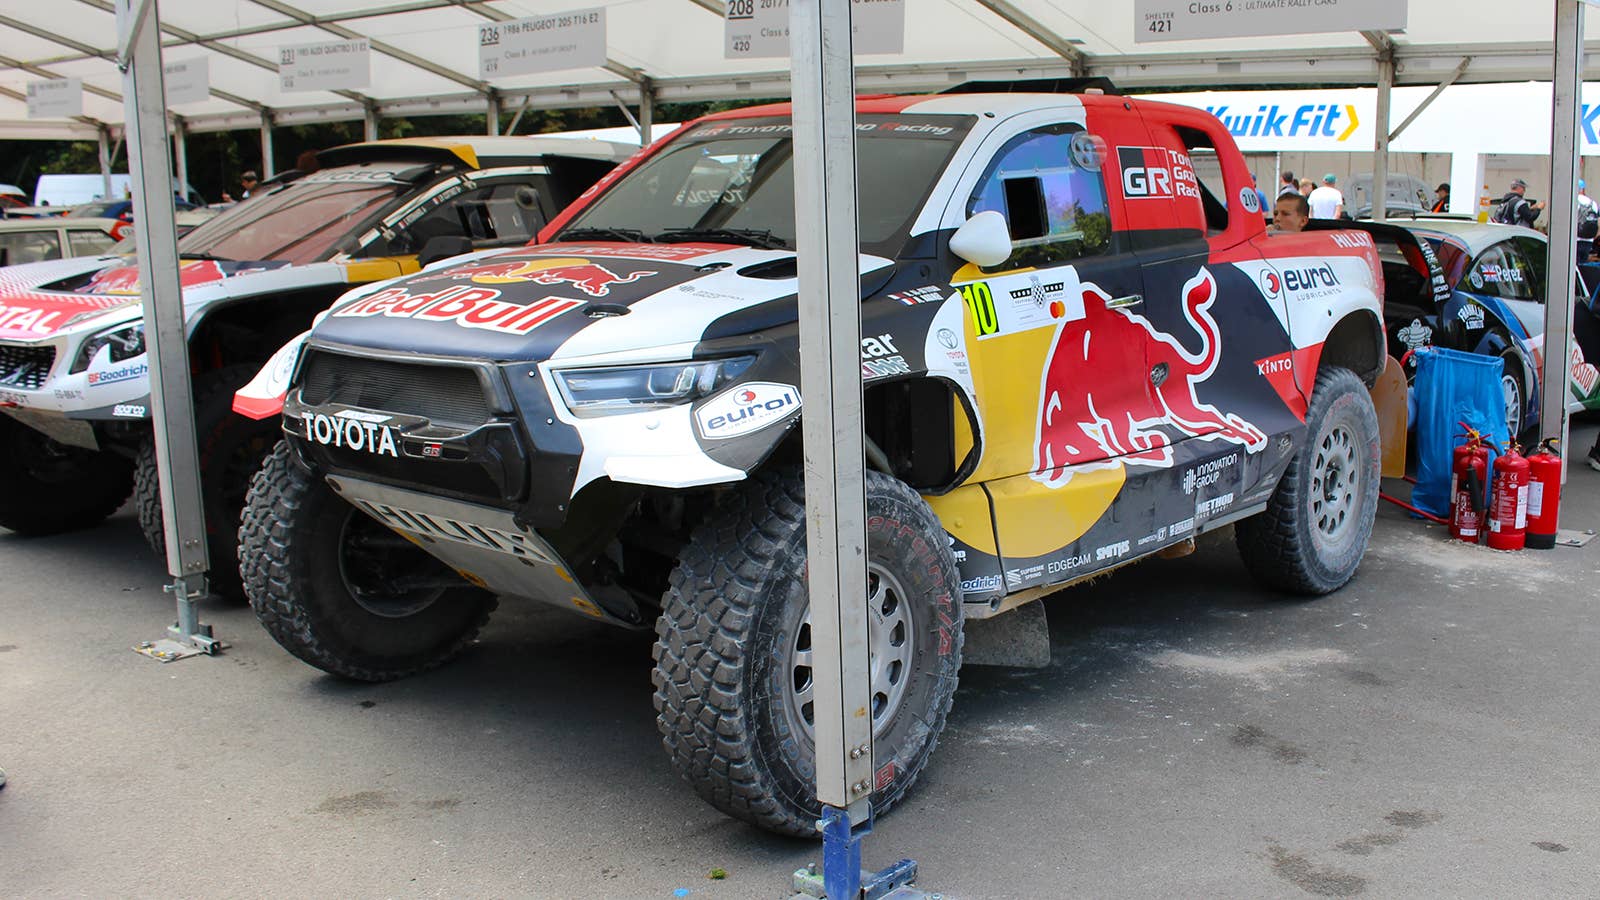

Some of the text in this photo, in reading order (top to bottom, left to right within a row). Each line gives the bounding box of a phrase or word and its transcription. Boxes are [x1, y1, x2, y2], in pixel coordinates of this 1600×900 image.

[729, 0, 754, 15] 208
[1189, 2, 1220, 14] Class
[1225, 1, 1233, 12] 6
[1245, 0, 1286, 10] ULTIMATE
[1287, 0, 1312, 8] RALLY
[503, 13, 599, 34] 1986 PEUGEOT 205 T16 E2
[1145, 12, 1175, 20] SHELTER
[481, 27, 500, 42] 236
[761, 28, 782, 37] Class
[1149, 20, 1172, 32] 421
[733, 41, 750, 51] 420
[878, 122, 955, 136] Racing
[1123, 167, 1173, 195] GR
[1243, 193, 1257, 207] 210
[1330, 232, 1372, 249] HILUX
[1284, 261, 1341, 291] eurol
[1496, 264, 1523, 281] Perez
[1297, 287, 1342, 302] LUBRICANTS
[88, 365, 148, 383] BFGoodrich
[1571, 348, 1596, 392] Castrol
[114, 404, 146, 416] sparco
[707, 393, 793, 430] eurol
[301, 412, 398, 457] TOYOTA
[1196, 471, 1220, 489] GROUP
[1197, 493, 1234, 513] METHOD
[1048, 553, 1092, 574] EDGECAM
